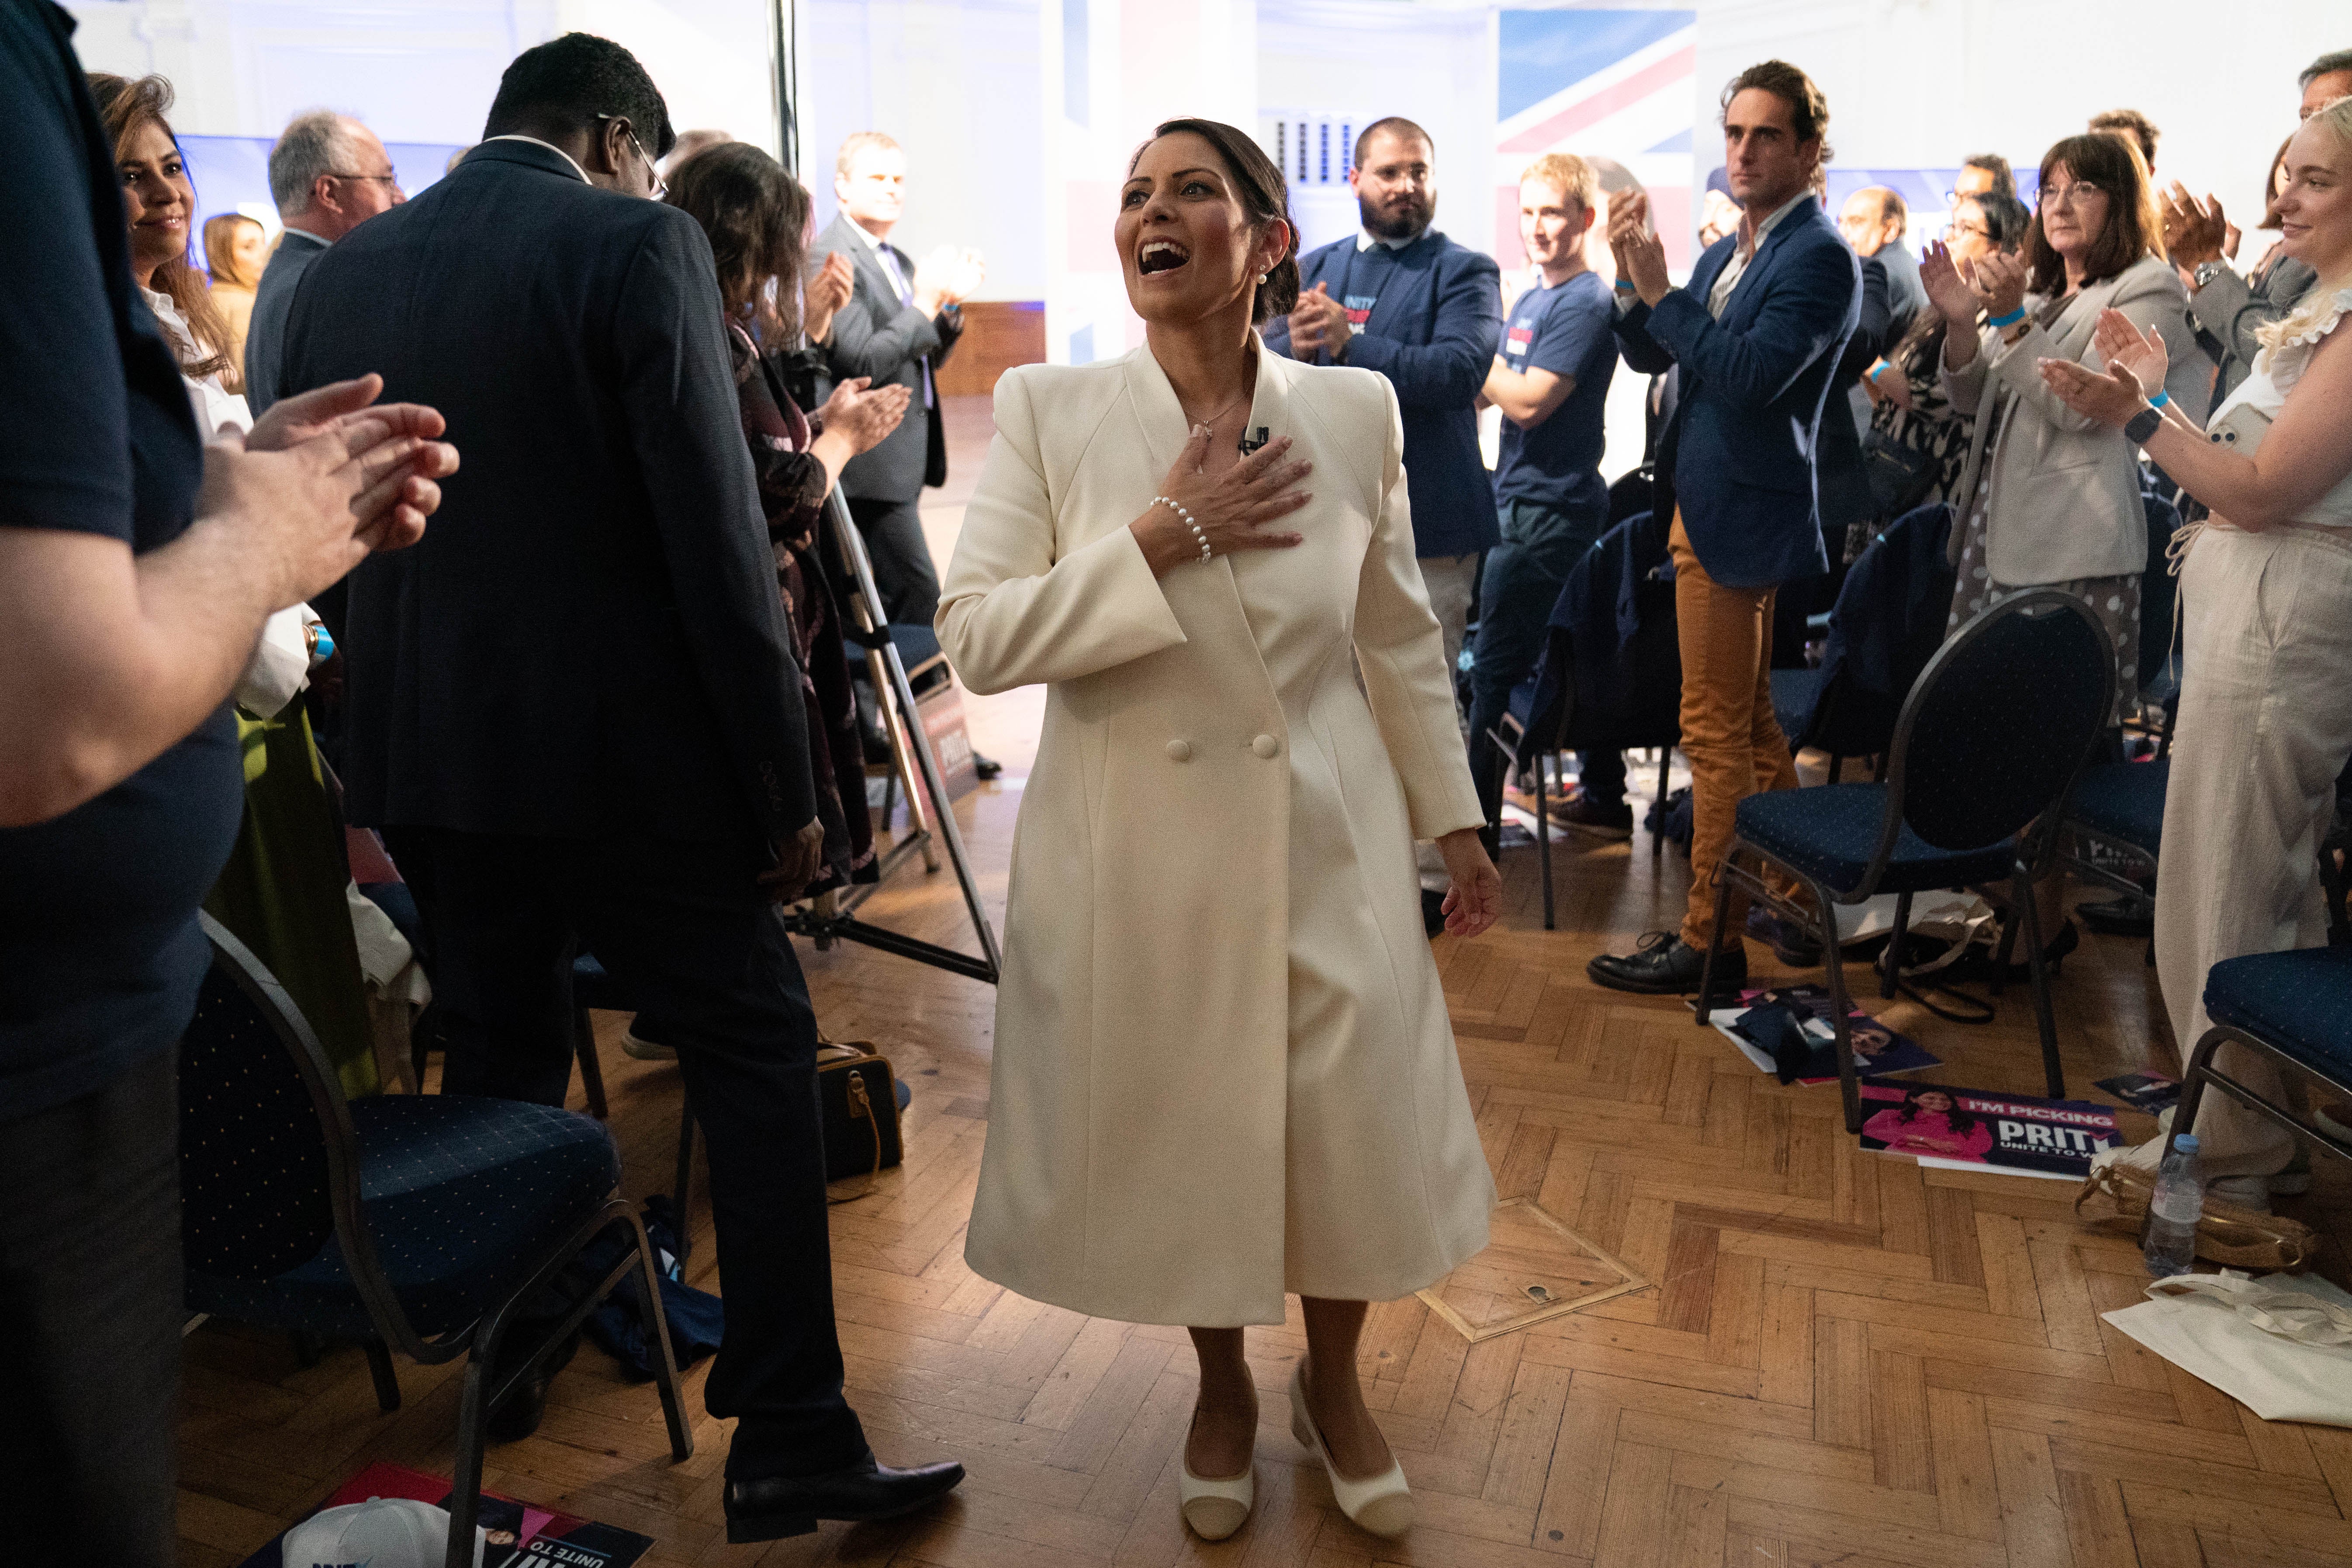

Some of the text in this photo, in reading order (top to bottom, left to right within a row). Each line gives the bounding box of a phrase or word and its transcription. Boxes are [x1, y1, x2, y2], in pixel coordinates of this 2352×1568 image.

[1969, 1100, 2113, 1126] I'M PICKING
[2000, 1141, 2048, 1153] UNITE
[2051, 1148, 2075, 1157] TO
[530, 1541, 553, 1555] TO
[553, 1548, 604, 1568] UNITE
